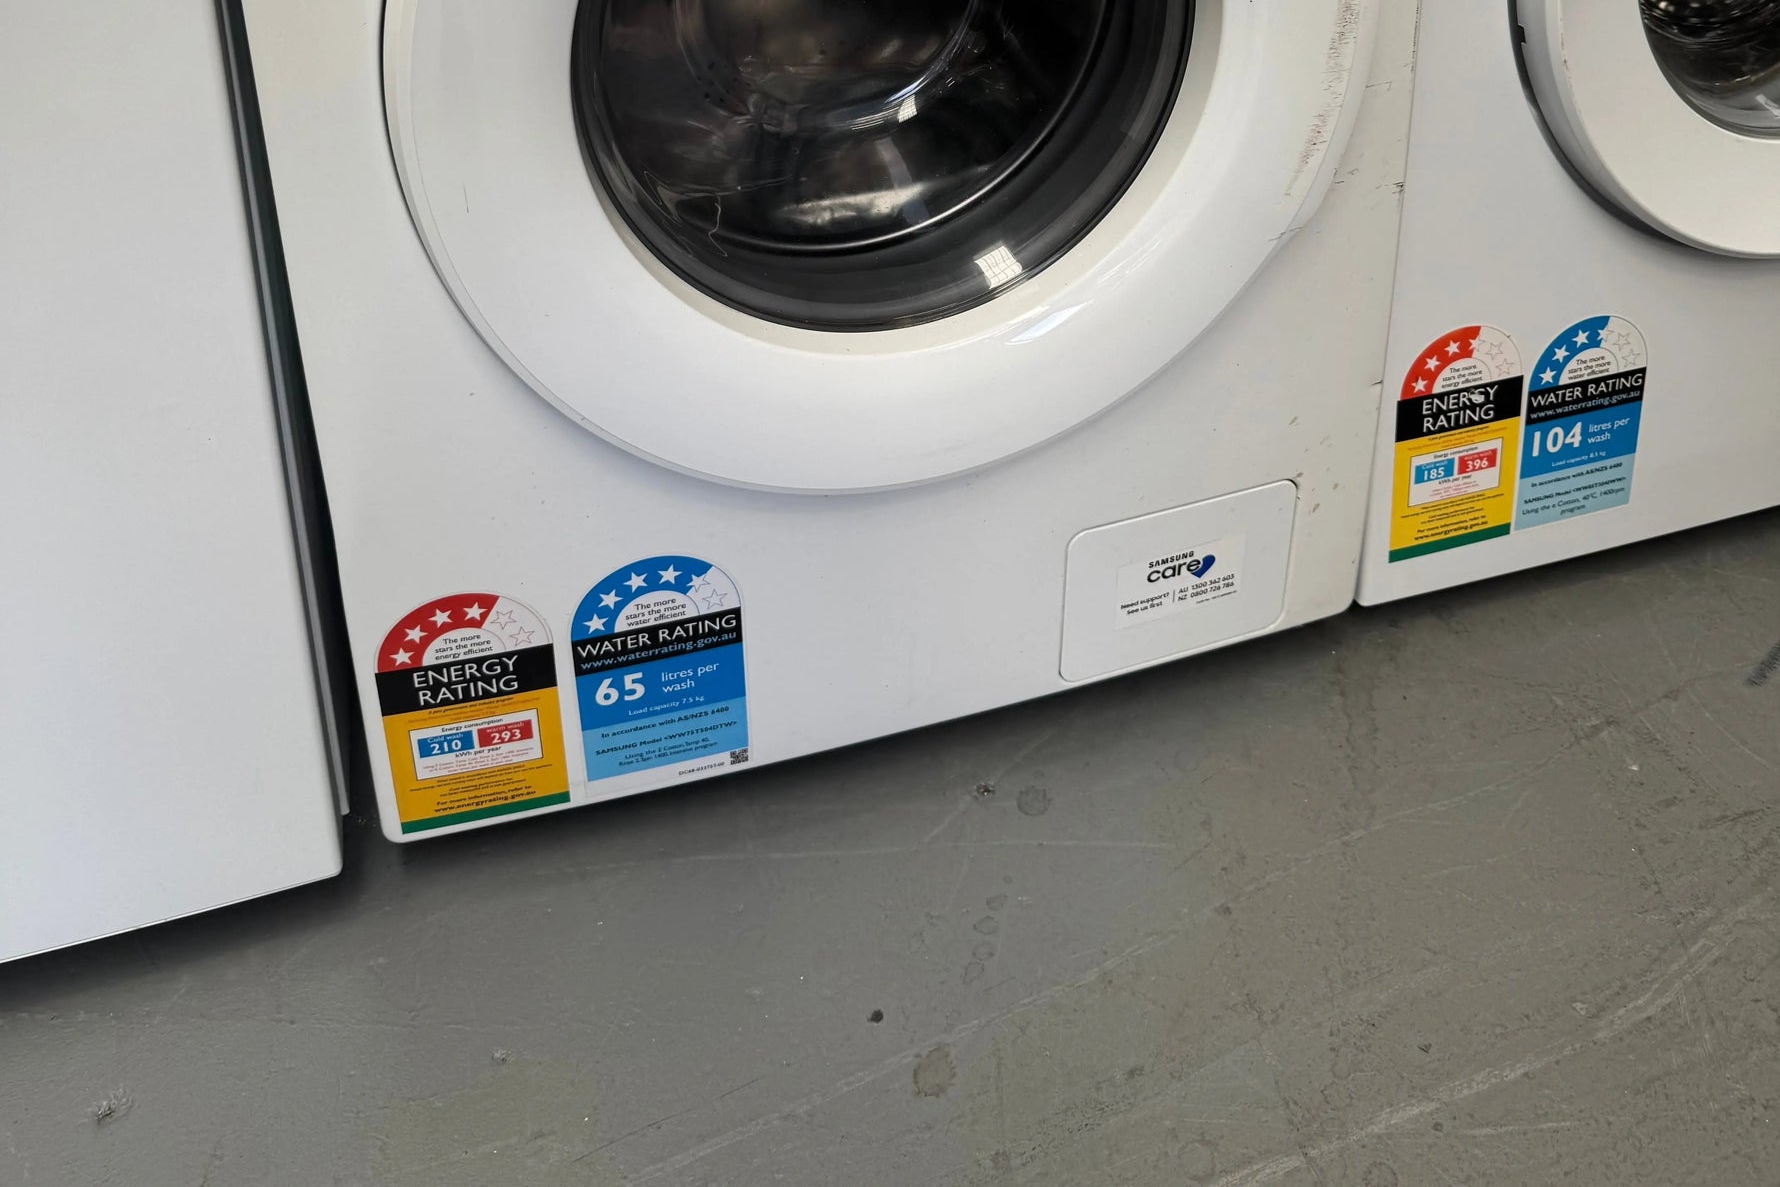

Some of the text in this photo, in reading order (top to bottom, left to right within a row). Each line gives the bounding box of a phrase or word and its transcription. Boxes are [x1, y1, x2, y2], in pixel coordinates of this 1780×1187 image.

[1531, 373, 1643, 408] WATER RATING
[1422, 385, 1499, 415] ENERGY
[1423, 404, 1495, 433] RATING
[1588, 417, 1630, 433] litres per
[1532, 421, 1582, 457] 104
[1587, 432, 1611, 444] wash
[1466, 457, 1489, 472] 396
[1423, 467, 1445, 481] 185
[1148, 550, 1195, 569] SAMSUNG
[1146, 559, 1201, 583] care
[625, 603, 687, 621] stars the more
[634, 598, 677, 611] The more
[626, 610, 687, 627] water efficient
[443, 634, 481, 645] The more
[577, 614, 737, 659] WATER RATING
[434, 639, 491, 654] stars the more
[435, 646, 493, 661] energy efficient
[580, 631, 737, 670] www.waterrating.gov.au
[413, 655, 519, 688] ENERGY
[661, 662, 720, 682] litres per
[418, 675, 519, 706] RATING
[595, 672, 646, 706] 65
[662, 679, 695, 694] wash
[490, 729, 522, 745] 293
[430, 740, 462, 755] 210
[595, 741, 638, 756] SAMSUNG
